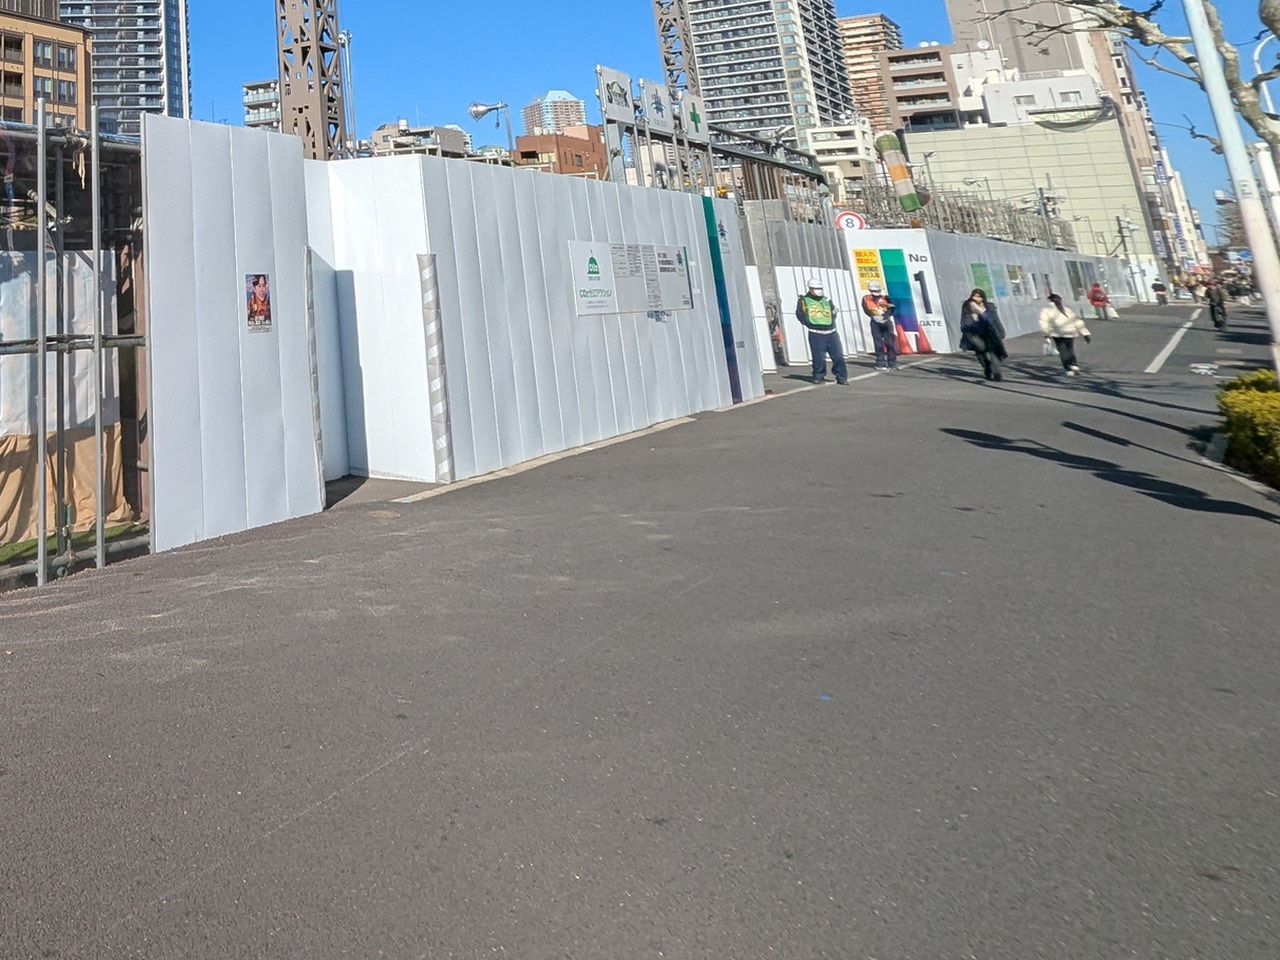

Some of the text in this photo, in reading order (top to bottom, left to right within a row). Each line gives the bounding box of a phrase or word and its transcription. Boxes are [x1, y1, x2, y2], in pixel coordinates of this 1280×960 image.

[845, 218, 855, 228] 8
[909, 253, 928, 263] No
[913, 270, 933, 314] 1
